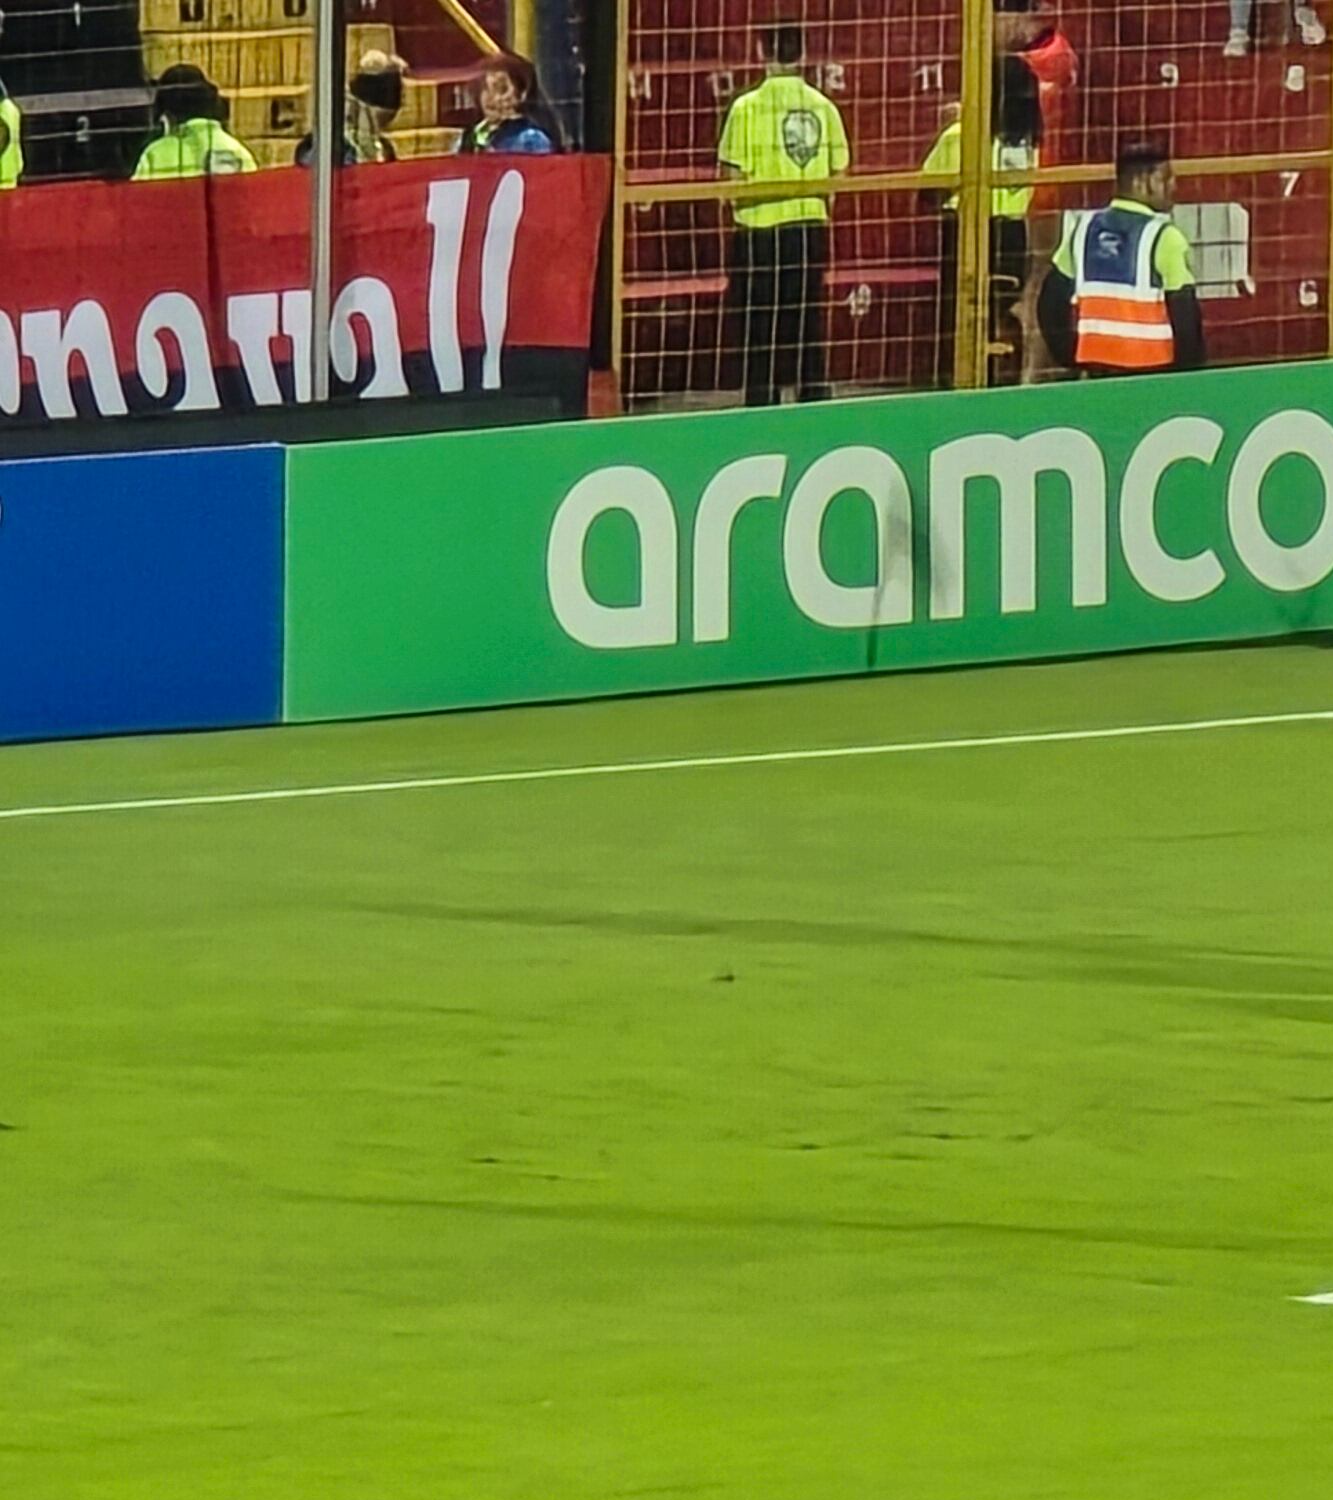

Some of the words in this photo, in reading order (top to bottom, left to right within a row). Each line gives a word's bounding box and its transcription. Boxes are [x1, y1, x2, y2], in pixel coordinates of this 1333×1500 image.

[1160, 62, 1180, 89] 9
[1279, 171, 1301, 198] 7
[1299, 279, 1319, 307] 6
